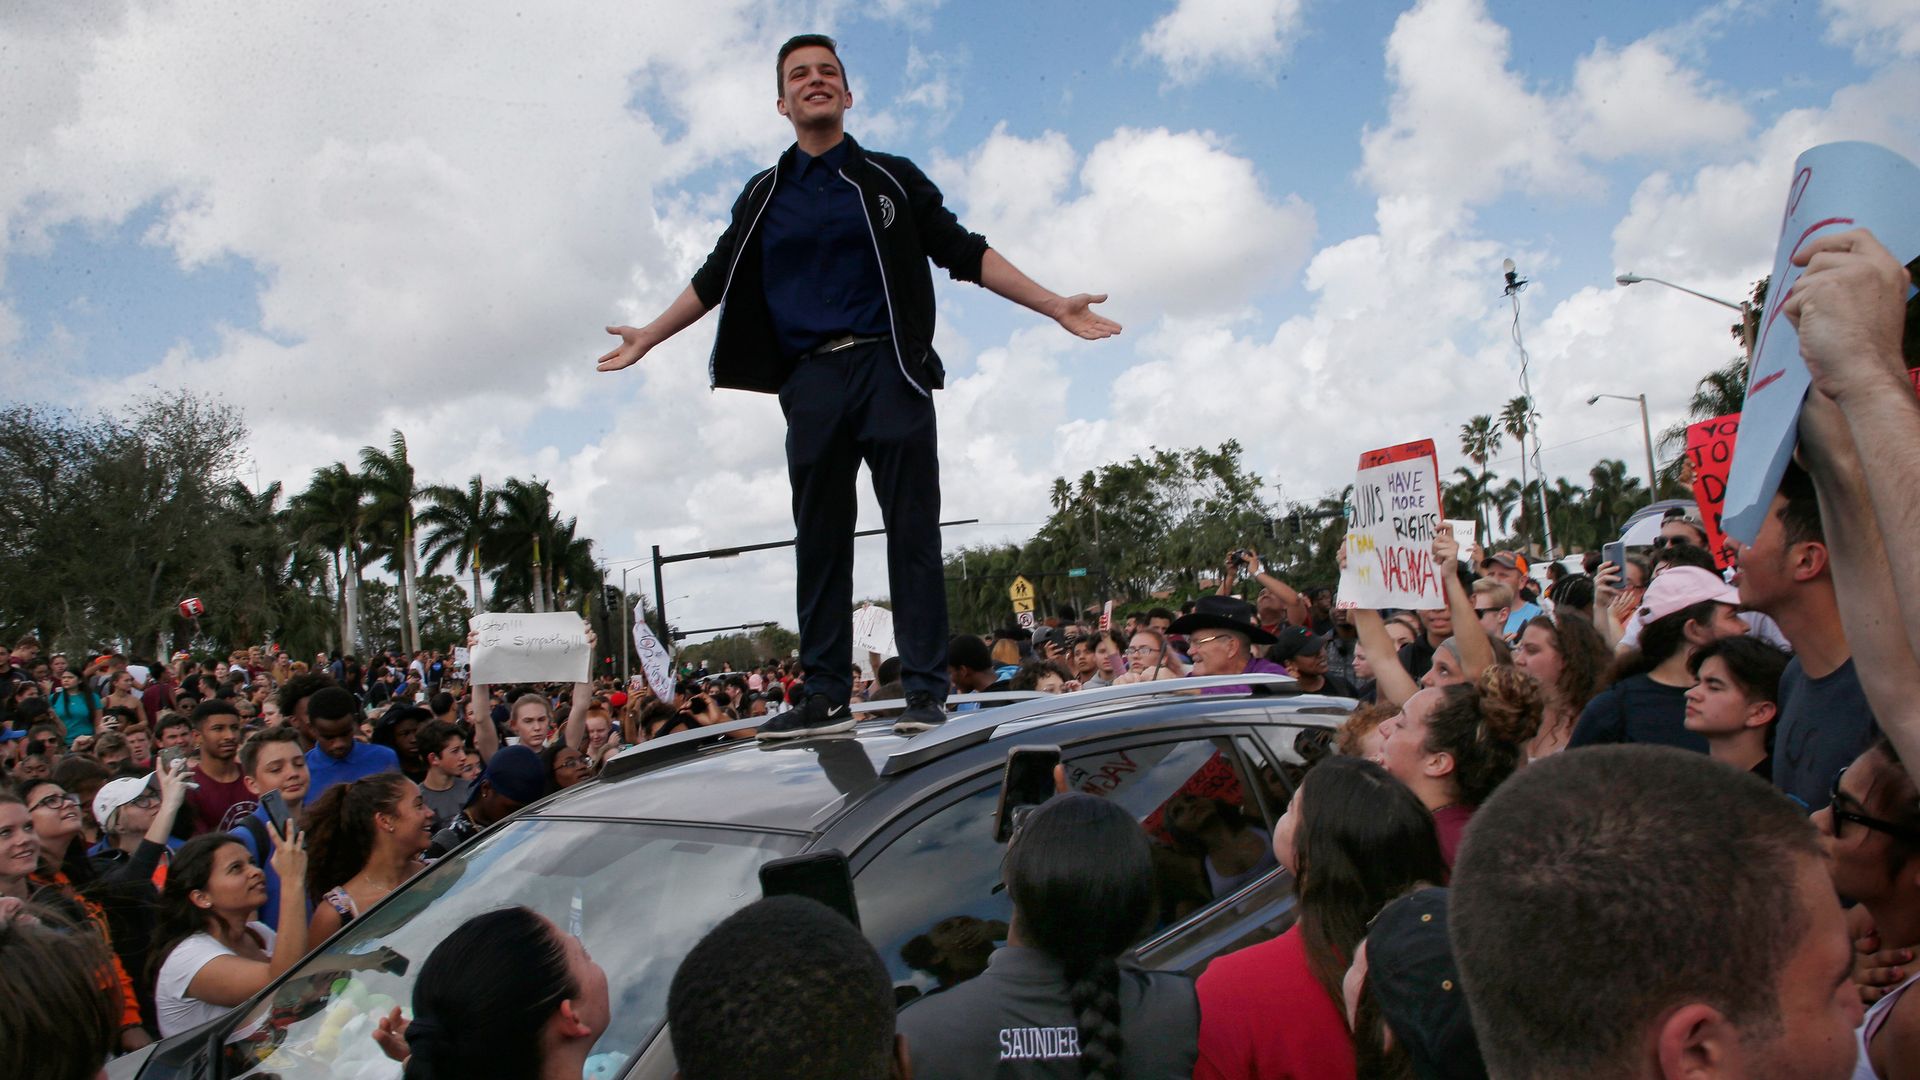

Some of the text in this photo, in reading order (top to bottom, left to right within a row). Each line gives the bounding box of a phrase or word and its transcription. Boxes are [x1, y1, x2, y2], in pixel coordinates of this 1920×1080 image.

[1688, 440, 1729, 468] TO
[1387, 471, 1423, 493] HAVE
[1392, 495, 1426, 511] MORE
[1393, 513, 1438, 541] RIGHTS
[1375, 545, 1440, 599] VAGINA
[999, 1027, 1082, 1060] SAUNDER
